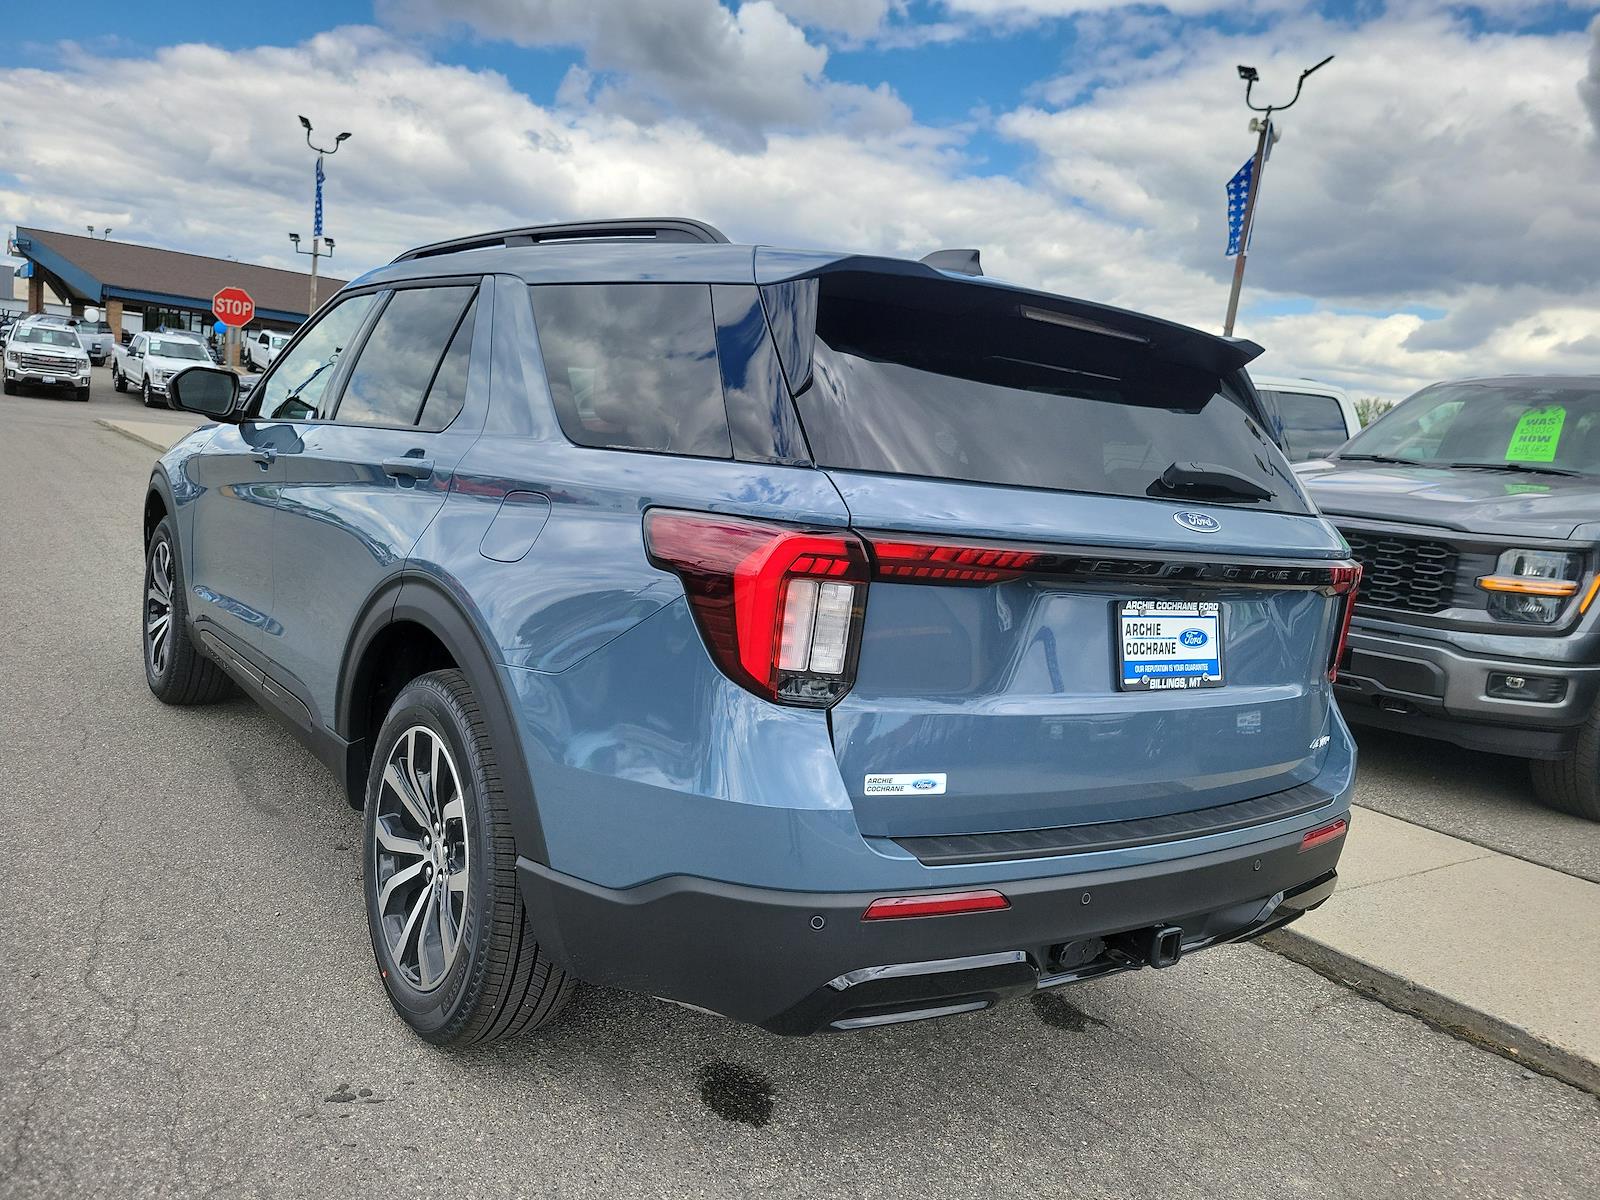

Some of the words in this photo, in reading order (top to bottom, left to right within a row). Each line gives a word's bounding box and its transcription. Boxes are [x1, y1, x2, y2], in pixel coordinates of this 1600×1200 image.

[215, 297, 252, 316] STOP
[1187, 513, 1214, 527] Ford
[1126, 601, 1154, 610] ARCHIE
[1156, 602, 1198, 611] COCHRANE
[1199, 602, 1219, 611] FORD
[1125, 623, 1162, 636] ARCHIE
[1184, 631, 1203, 645] Ford
[1126, 642, 1177, 655] COCHRANE
[1134, 665, 1144, 673] OUR
[1144, 664, 1168, 673] REPUTATION
[1173, 664, 1184, 672] YOUR
[1184, 663, 1209, 671] GUARANTEE
[1189, 677, 1202, 687] MT
